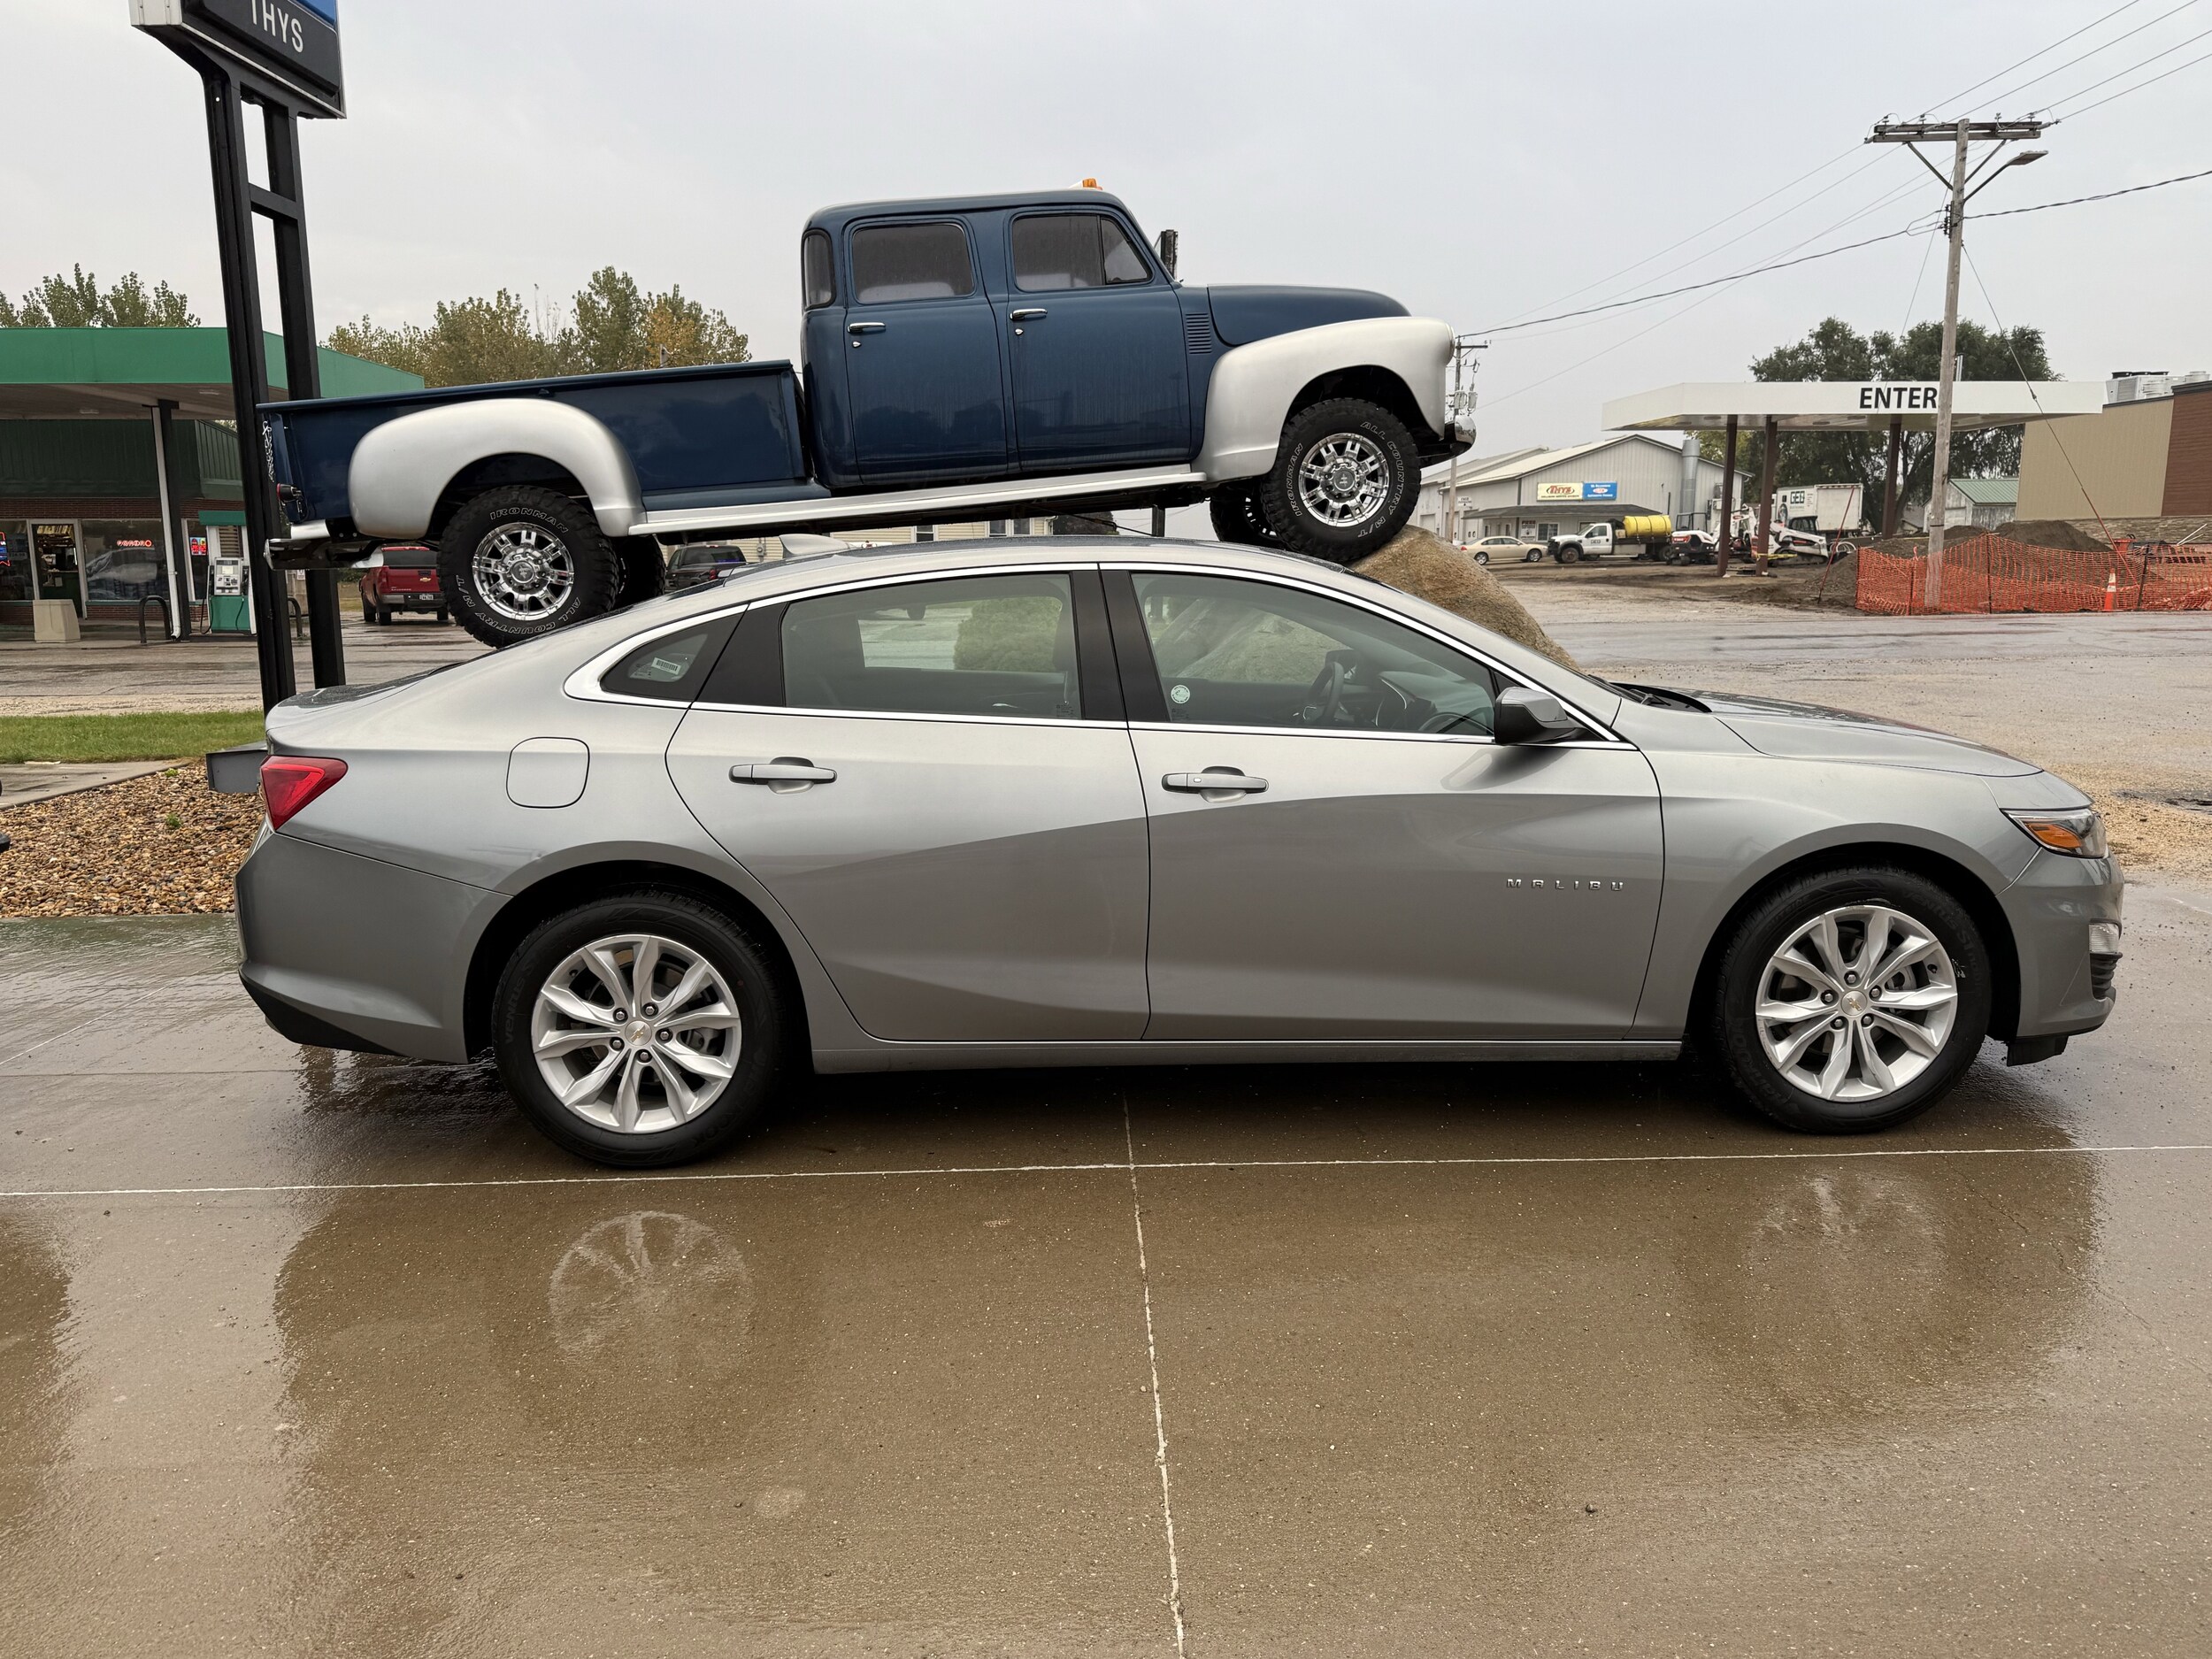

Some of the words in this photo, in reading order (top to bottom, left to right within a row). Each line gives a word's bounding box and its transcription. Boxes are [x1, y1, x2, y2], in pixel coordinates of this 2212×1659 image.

[1860, 387, 1938, 409] ENTER
[1360, 421, 1386, 441] ALL
[1286, 443, 1303, 517] IRONMAN
[1386, 441, 1405, 515] COUNTRY
[489, 507, 569, 534] IRONMAN
[1357, 516, 1386, 538] M/T
[456, 575, 476, 608] M/T
[558, 597, 581, 622] ALL
[475, 612, 556, 634] COUNTRY
[1506, 879, 1624, 891] MALIBU
